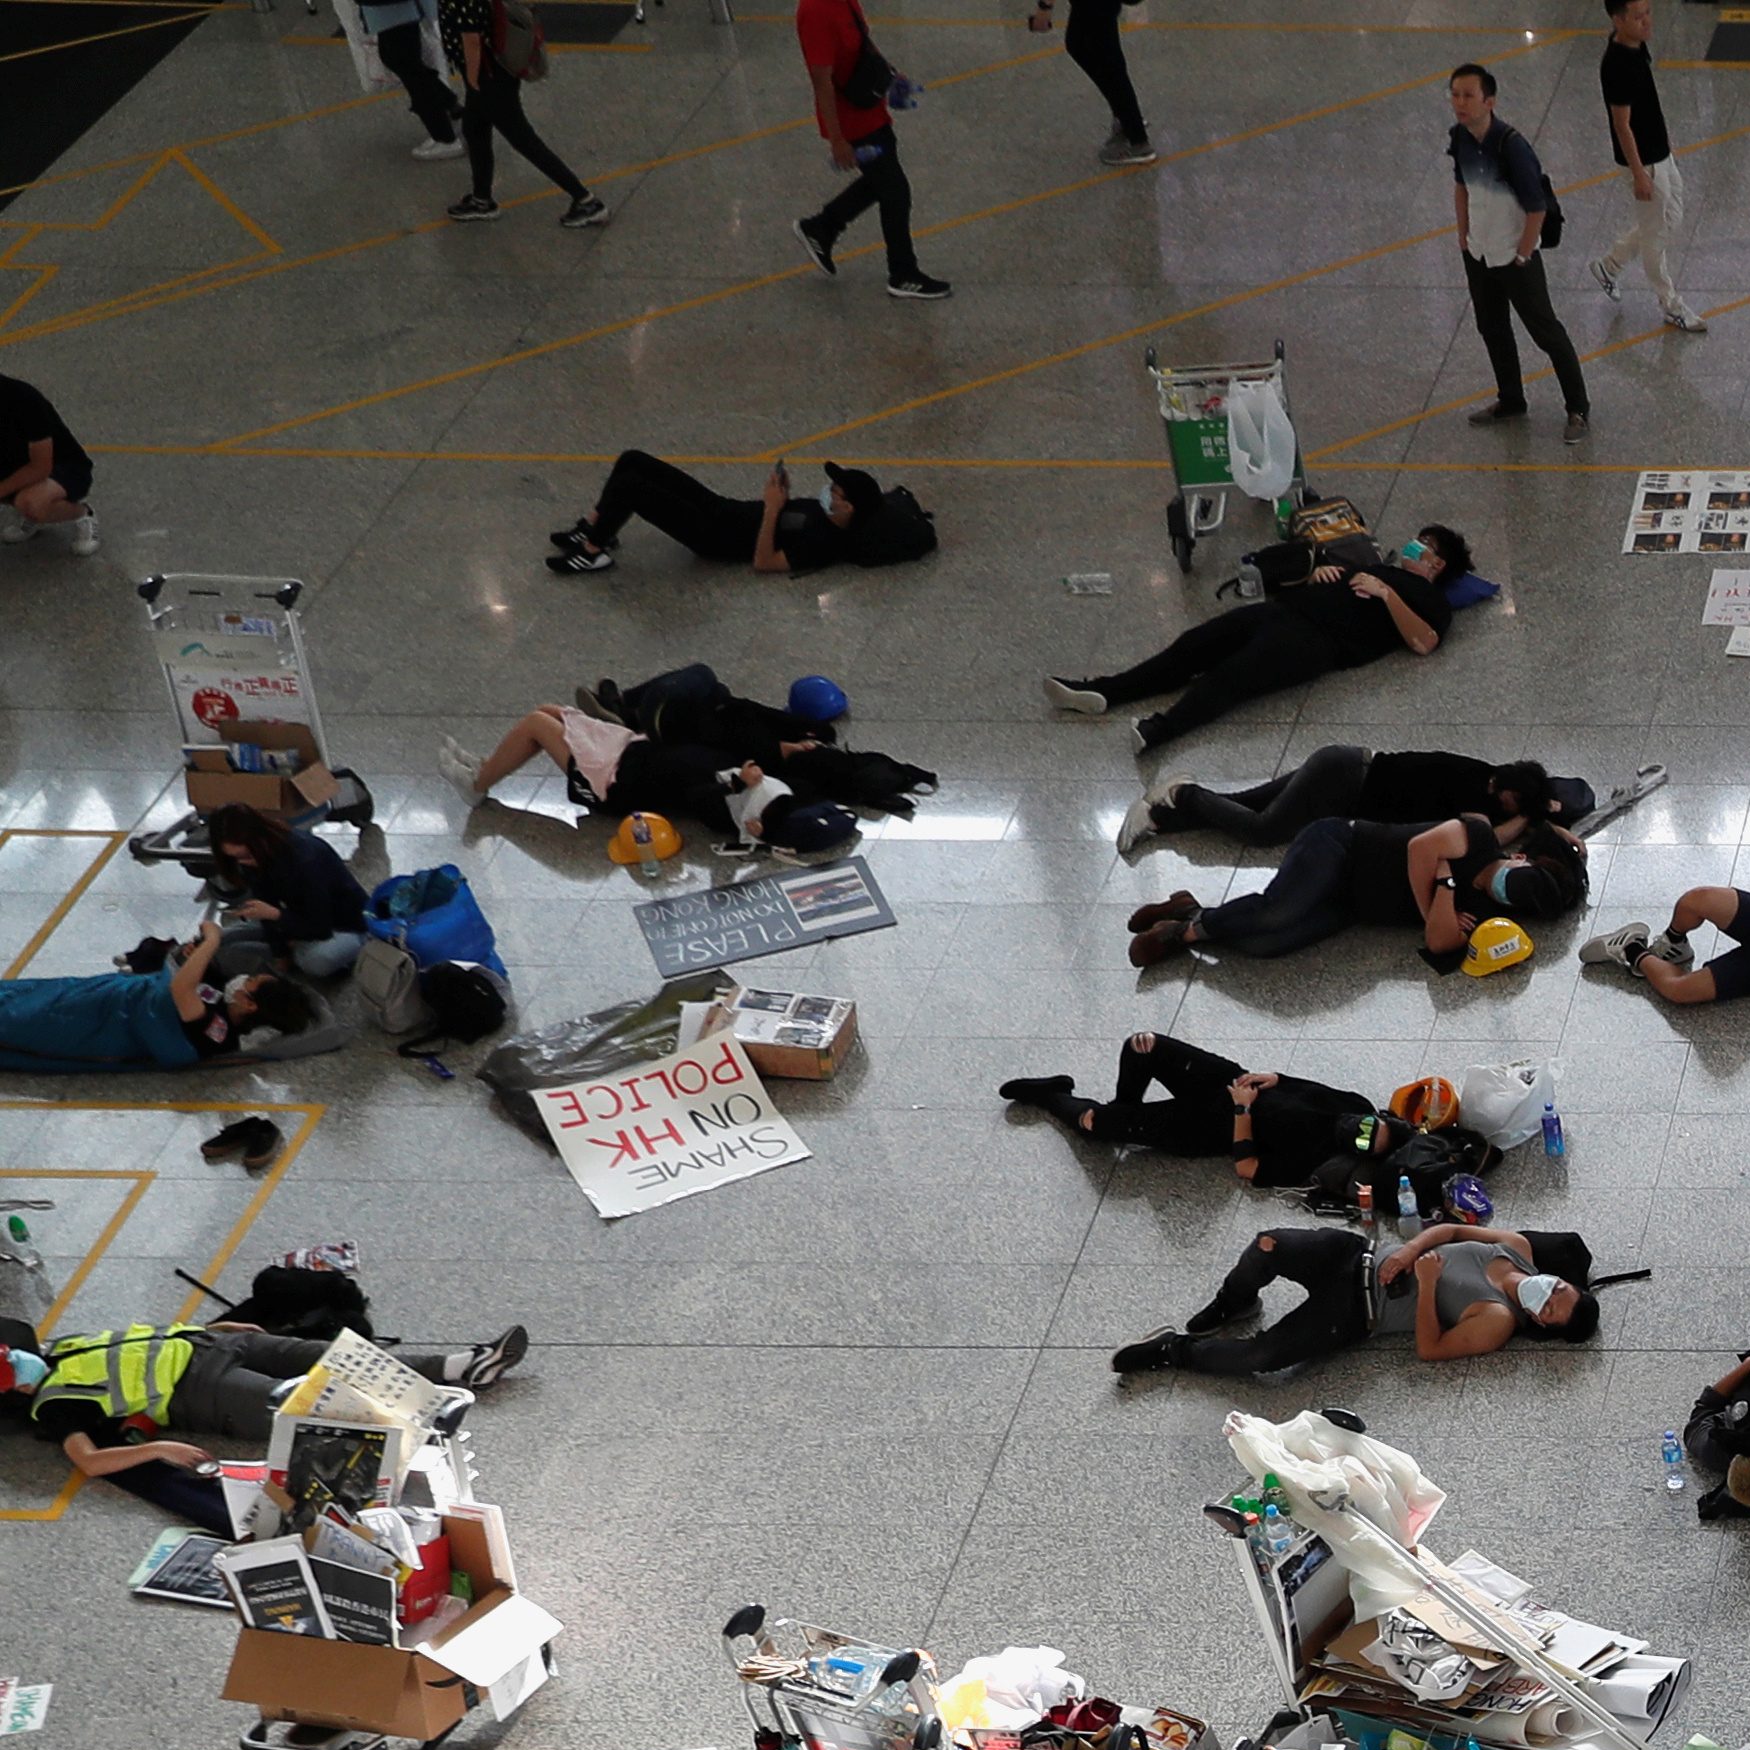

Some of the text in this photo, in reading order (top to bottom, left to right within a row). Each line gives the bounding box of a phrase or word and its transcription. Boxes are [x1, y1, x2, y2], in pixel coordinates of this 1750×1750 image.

[640, 879, 781, 921] HONG KONG
[665, 923, 797, 965] PLEASE
[546, 1042, 744, 1128] POLICE
[588, 1094, 761, 1168] ON HK
[628, 1127, 789, 1190] SHAME
